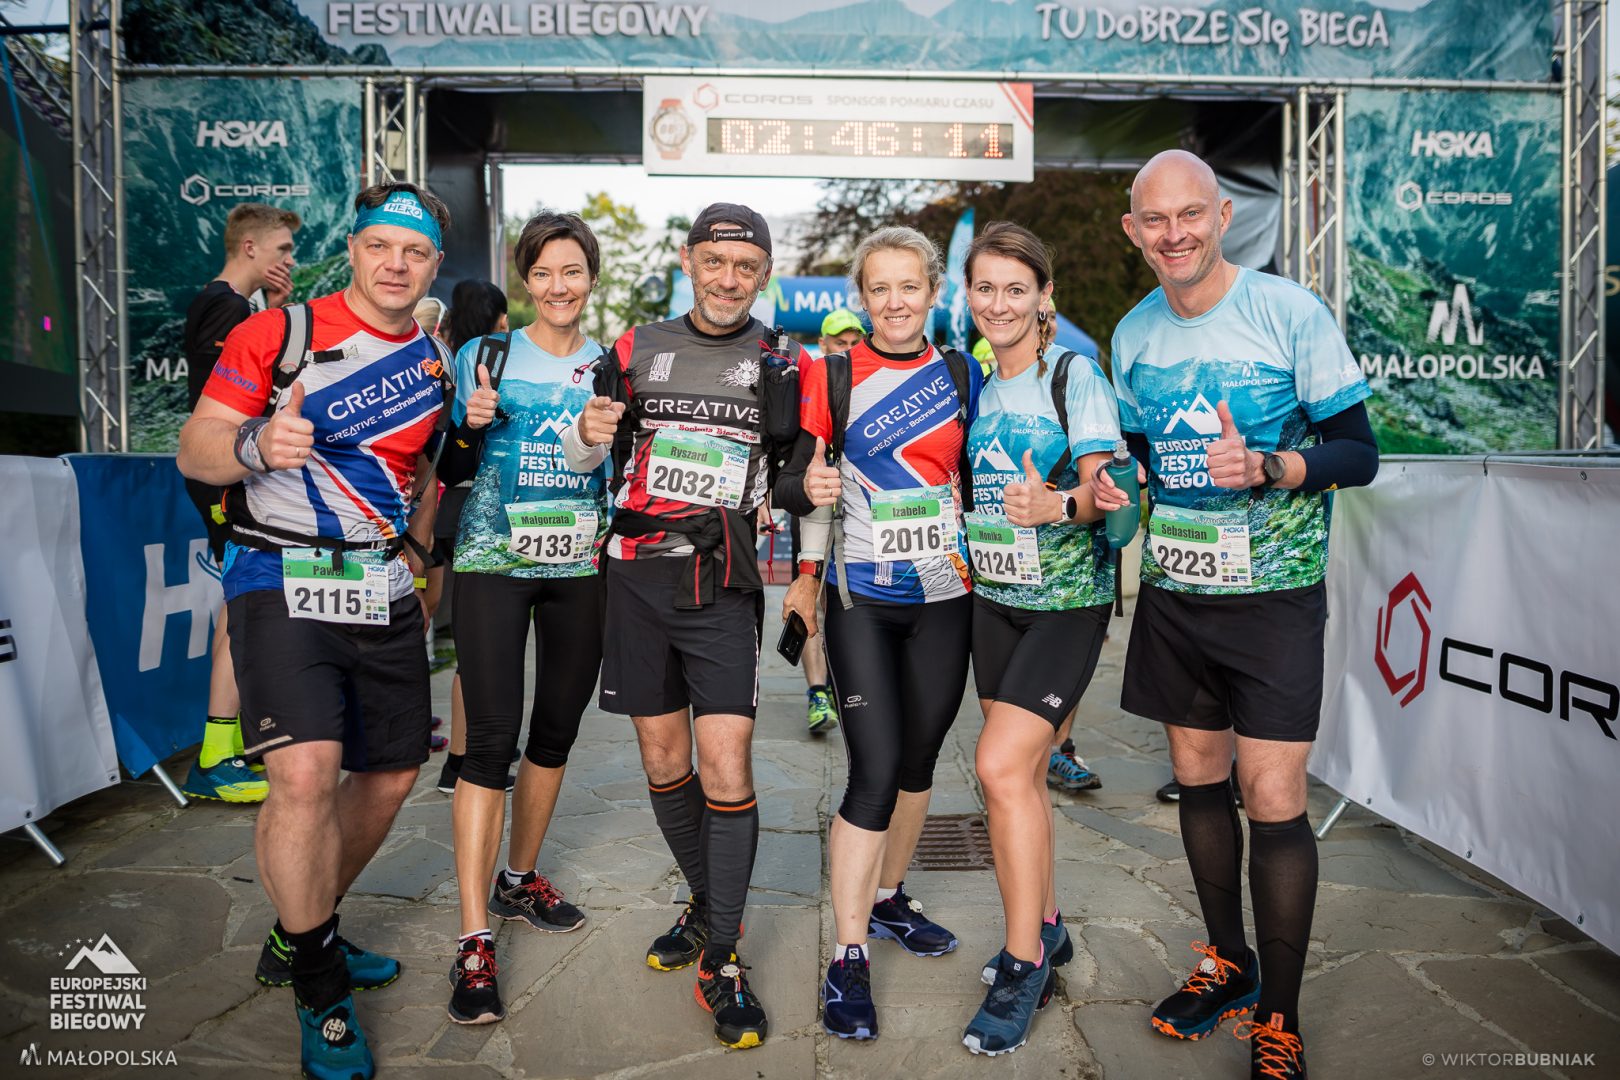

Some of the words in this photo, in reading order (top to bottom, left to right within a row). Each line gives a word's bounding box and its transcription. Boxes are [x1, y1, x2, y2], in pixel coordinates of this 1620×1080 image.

[327, 3, 522, 36] FESTIWAL
[530, 3, 706, 37] BIEGOWY
[1035, 4, 1088, 40] TU
[1298, 8, 1390, 48] BIEGA
[724, 93, 813, 106] COROS
[827, 95, 887, 108] SPONSOR
[890, 96, 950, 109] POMIARU
[953, 97, 1005, 109] CZASU
[196, 120, 289, 149] HOKA
[1411, 129, 1494, 159] HOKA
[214, 184, 310, 197] COROS
[1426, 192, 1513, 206] COROS
[388, 203, 421, 217] HERO
[1359, 353, 1546, 380] MAŁOPOLSKA
[1221, 378, 1279, 388] MAŁOPOLSKA
[326, 415, 378, 443] CREATIVE
[382, 396, 417, 418] Bochnia
[644, 398, 760, 424] CREATIVE
[863, 375, 950, 439] CREATIVE
[867, 427, 906, 457] CREATIVE
[909, 407, 937, 428] Bochnia
[670, 446, 708, 464] Ryszard
[517, 471, 593, 490] BIEGOWY
[652, 465, 716, 499] 2032
[972, 473, 1025, 486] UROPEJSKI
[892, 505, 927, 519] Izabela
[880, 524, 941, 554] 2016
[1161, 523, 1208, 540] Sebastian
[515, 534, 573, 558] 2133
[974, 549, 1018, 576] 2124
[1157, 544, 1217, 578] 2223
[294, 586, 362, 616] 2115
[1439, 636, 1620, 741] COR
